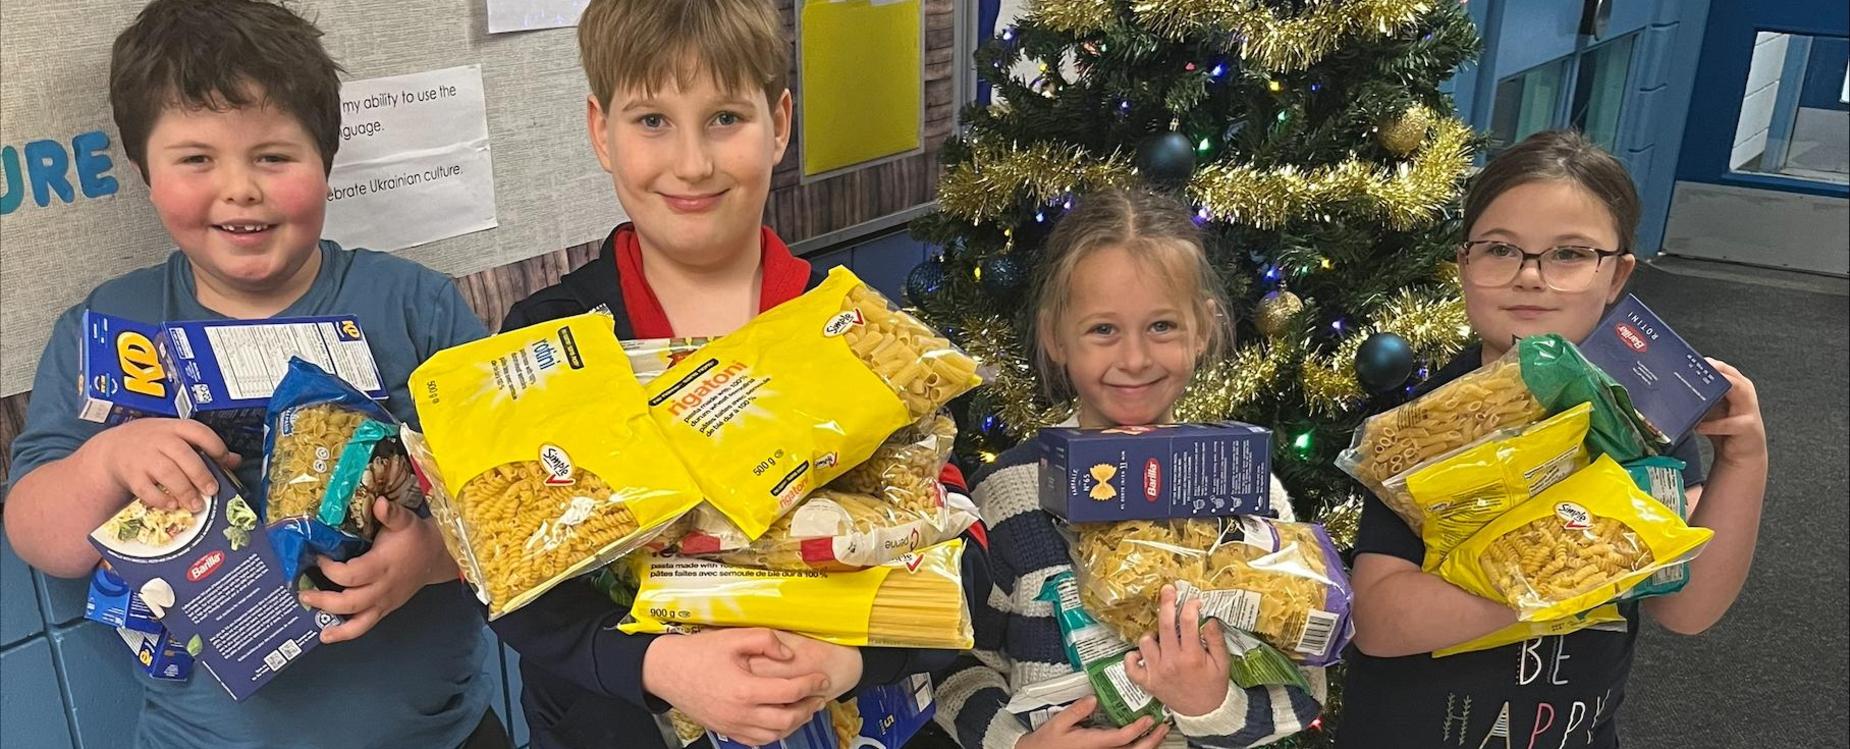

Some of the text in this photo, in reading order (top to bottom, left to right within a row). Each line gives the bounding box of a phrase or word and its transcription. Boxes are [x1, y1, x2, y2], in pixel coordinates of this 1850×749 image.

[342, 85, 457, 114] my ability to use the
[370, 172, 422, 193] Ukrainian
[424, 164, 464, 182] culture.
[1618, 326, 1645, 349] Barilla
[1627, 311, 1660, 340] ROTINI
[117, 331, 166, 398] KD
[532, 338, 561, 370] rotini
[668, 360, 748, 416] rigatoni
[543, 448, 570, 476] Simple
[753, 461, 769, 476] 500
[1146, 462, 1157, 496] Barilla
[1558, 503, 1586, 522] Simple
[192, 553, 221, 579] Barilla
[650, 570, 673, 578] pâtes
[650, 608, 667, 617] 900
[1516, 635, 1570, 685] BE
